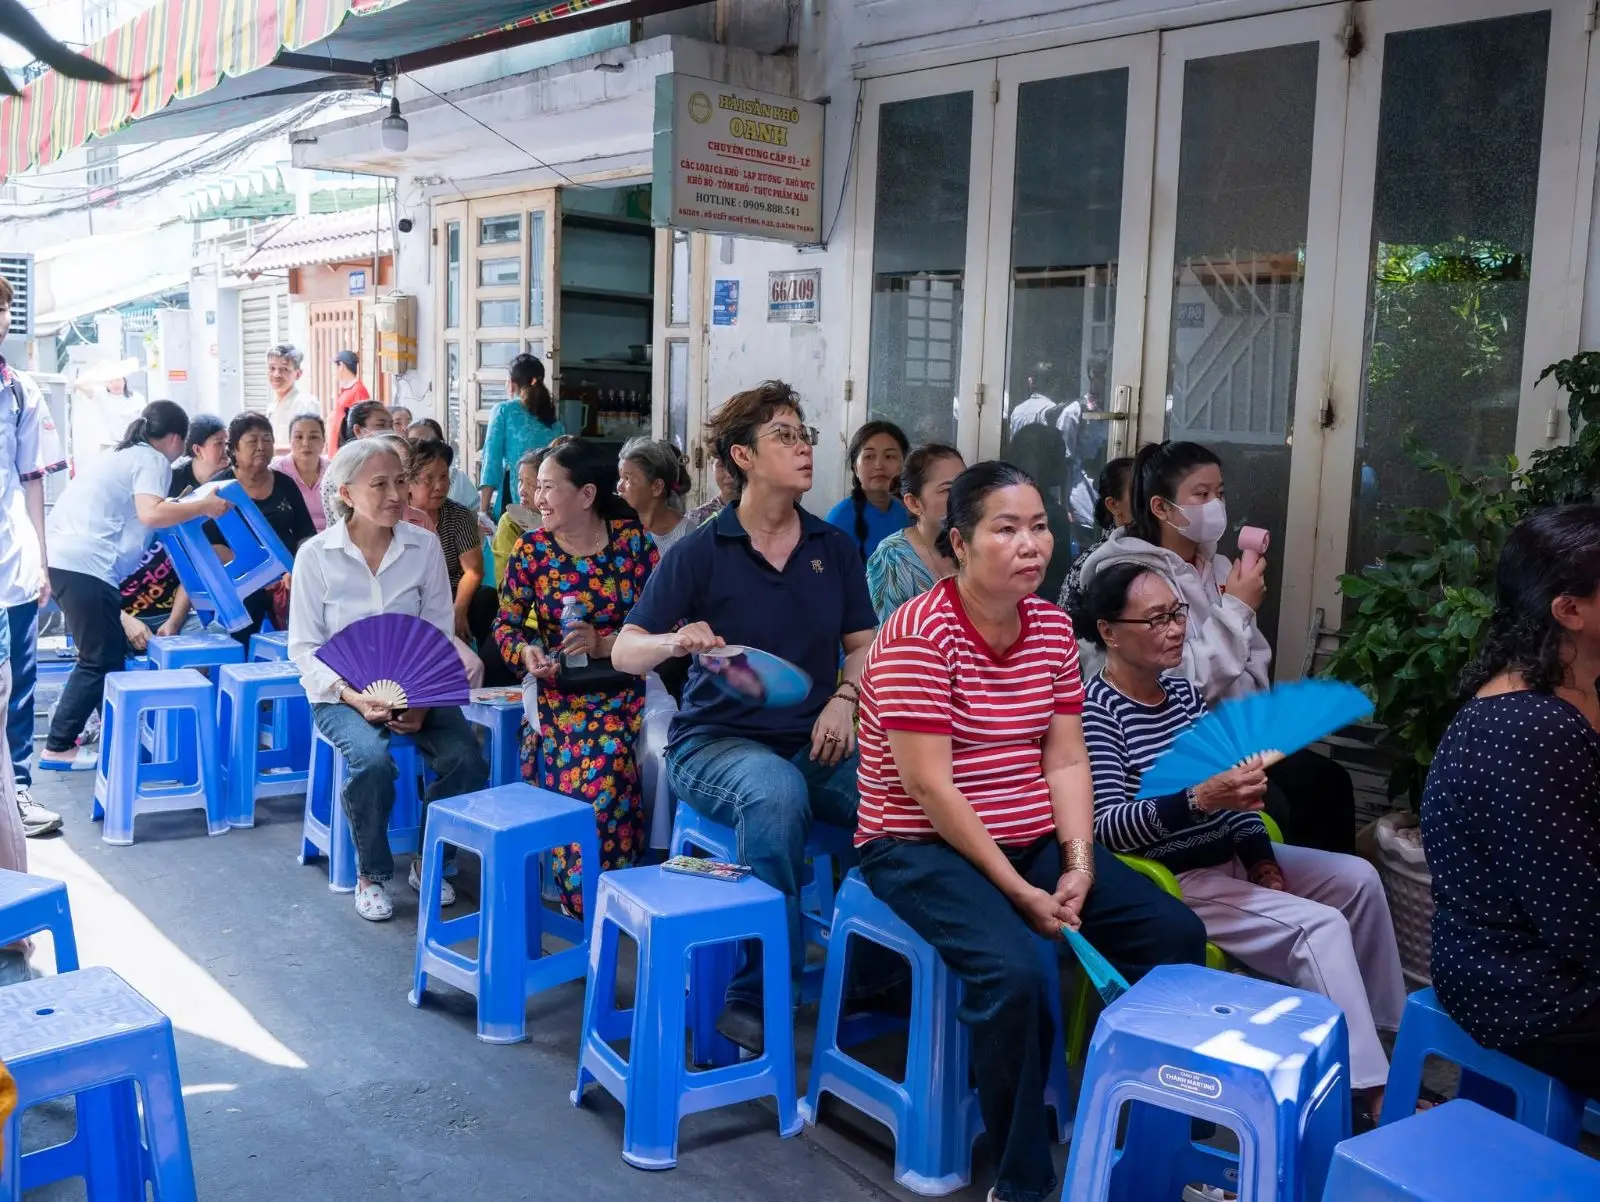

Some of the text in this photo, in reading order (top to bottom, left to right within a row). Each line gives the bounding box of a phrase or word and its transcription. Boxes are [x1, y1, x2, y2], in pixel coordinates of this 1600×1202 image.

[771, 106, 800, 124] KHÔ
[729, 117, 788, 146] OANH
[708, 141, 744, 156] CHUYÊN
[745, 148, 769, 160] CUNG
[770, 151, 787, 163] CẤP
[681, 159, 695, 169] CÁC
[696, 192, 737, 207] HOTLINE
[743, 201, 800, 217] 0909.888.541
[772, 278, 815, 302] 66/109
